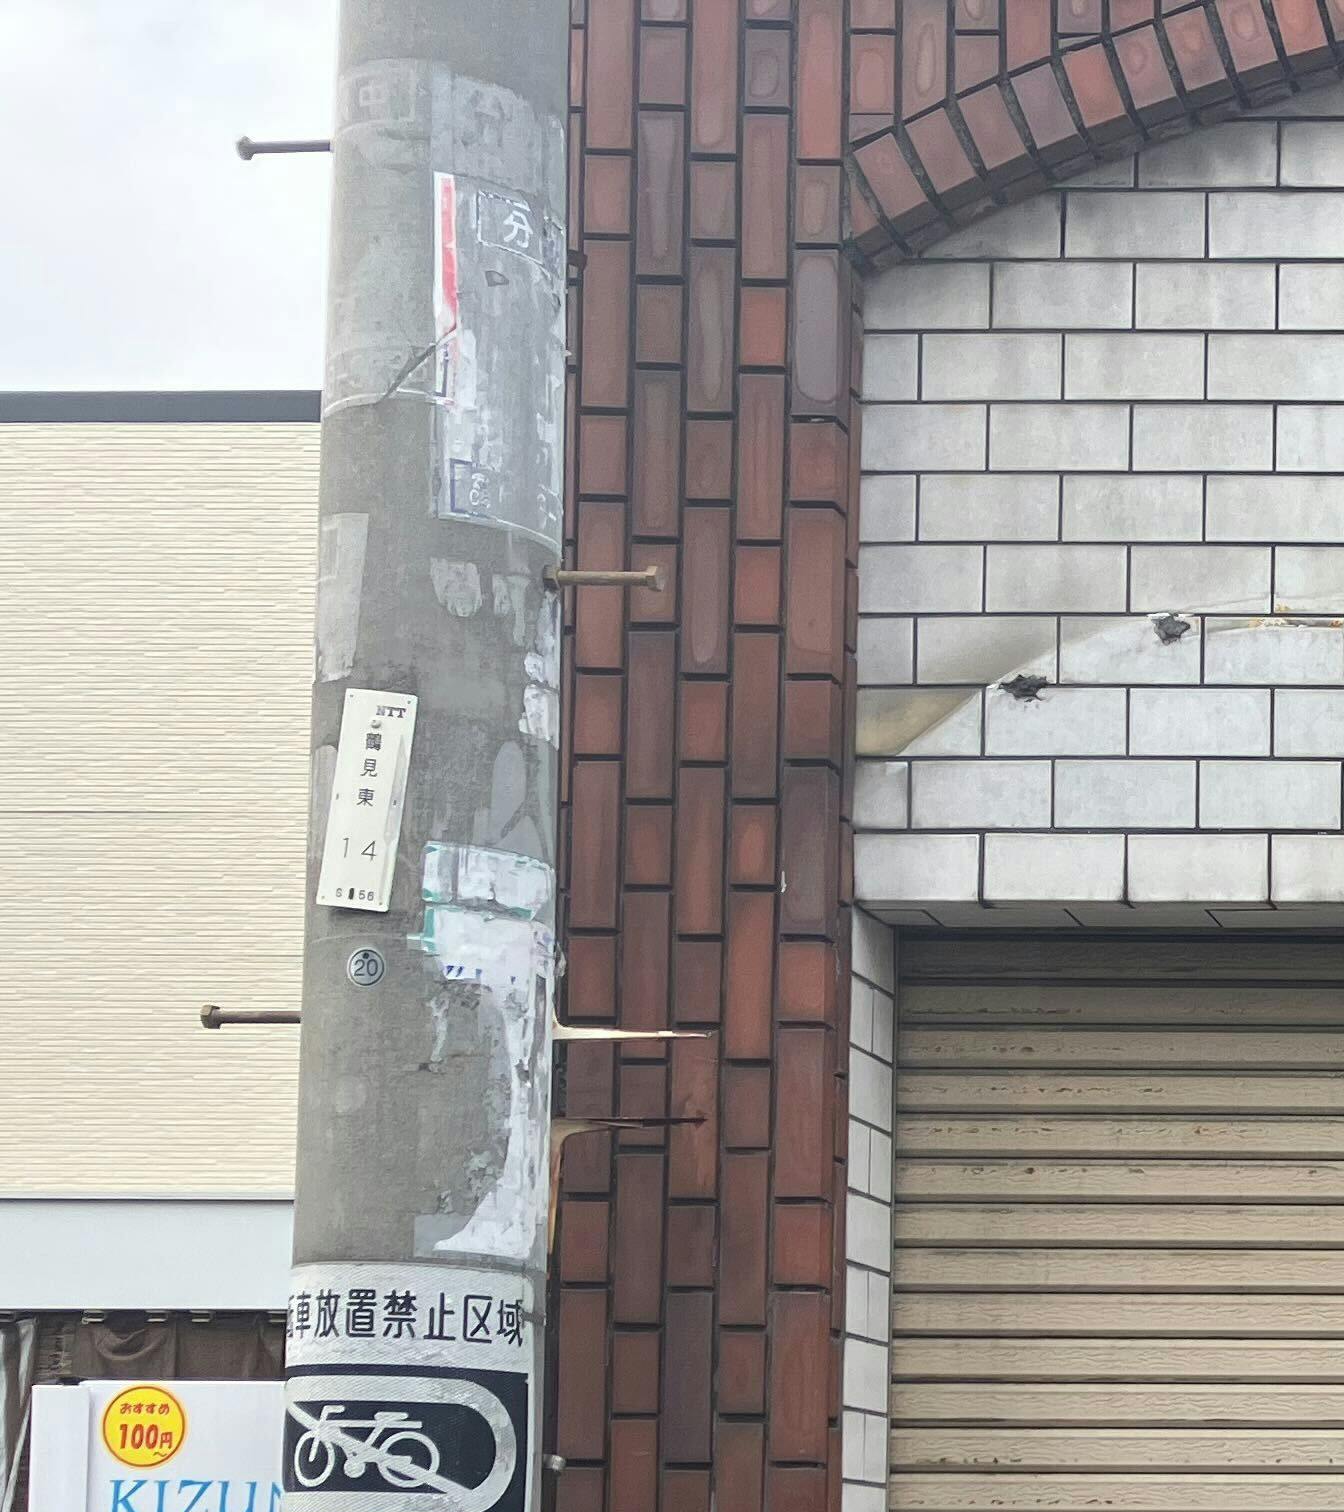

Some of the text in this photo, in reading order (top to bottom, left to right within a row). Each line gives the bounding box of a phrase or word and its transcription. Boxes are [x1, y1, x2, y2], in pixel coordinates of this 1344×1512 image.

[376, 705, 407, 718] NTT
[343, 837, 377, 861] 14
[354, 959, 378, 976] 20
[287, 1288, 523, 1347] 車放置禁止区域
[120, 1403, 170, 1415] おすすめ
